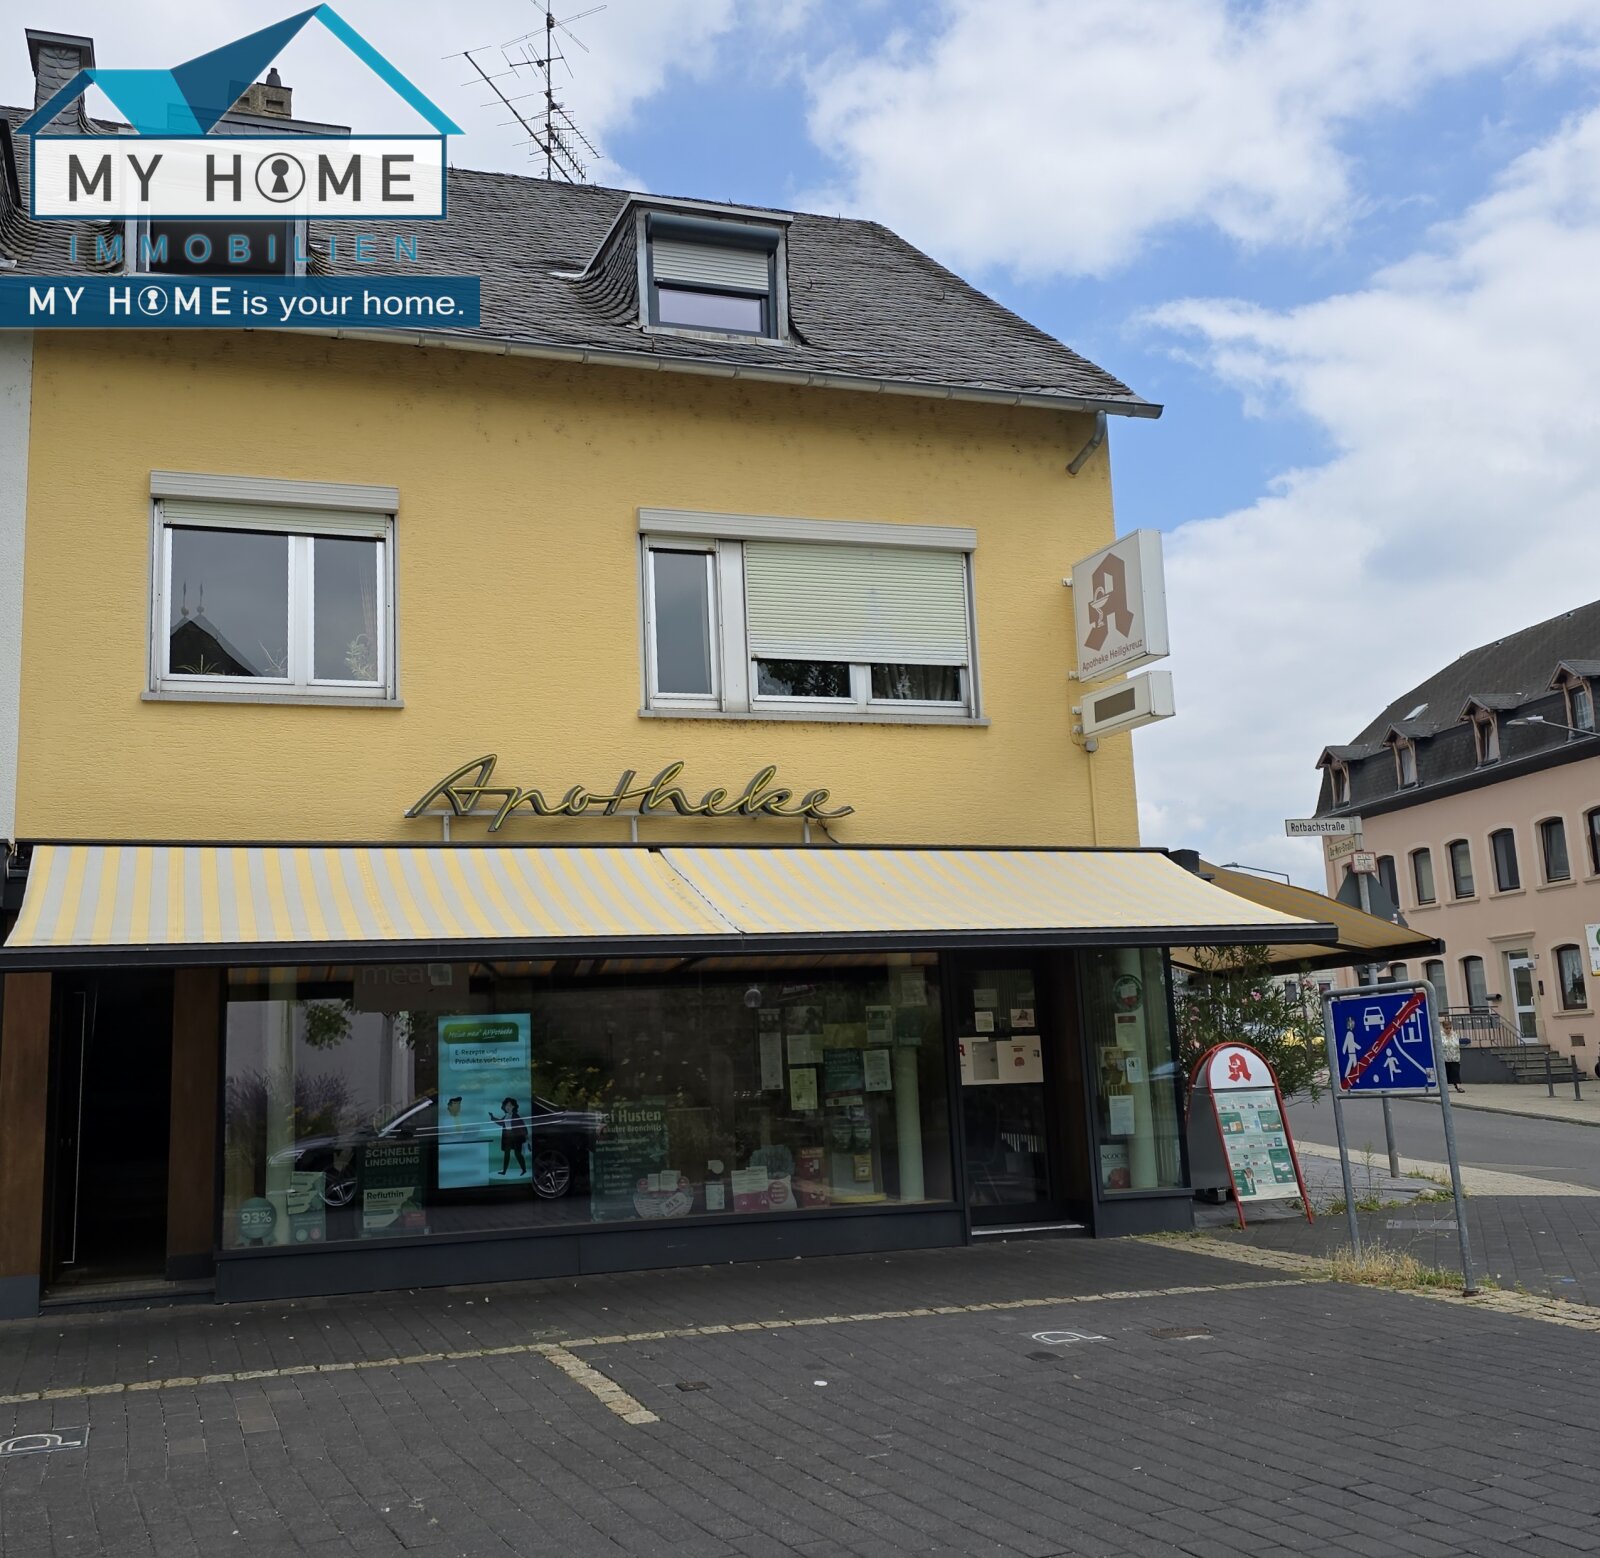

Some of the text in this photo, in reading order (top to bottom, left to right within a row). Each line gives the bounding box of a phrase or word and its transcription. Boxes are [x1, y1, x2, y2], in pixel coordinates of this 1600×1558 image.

[1082, 639, 1143, 672] Apotheke Heiligkreuz
[403, 754, 856, 832] Apotheke
[1290, 822, 1346, 833] Rotbachstraße
[455, 1056, 520, 1065] Produkte vorbestellen
[618, 1109, 662, 1122] Husten
[366, 1146, 420, 1158] SCHNELLE
[365, 1156, 420, 1168] LINDERUNG
[367, 1190, 404, 1200] Refluthin
[241, 1210, 273, 1225] 93%
